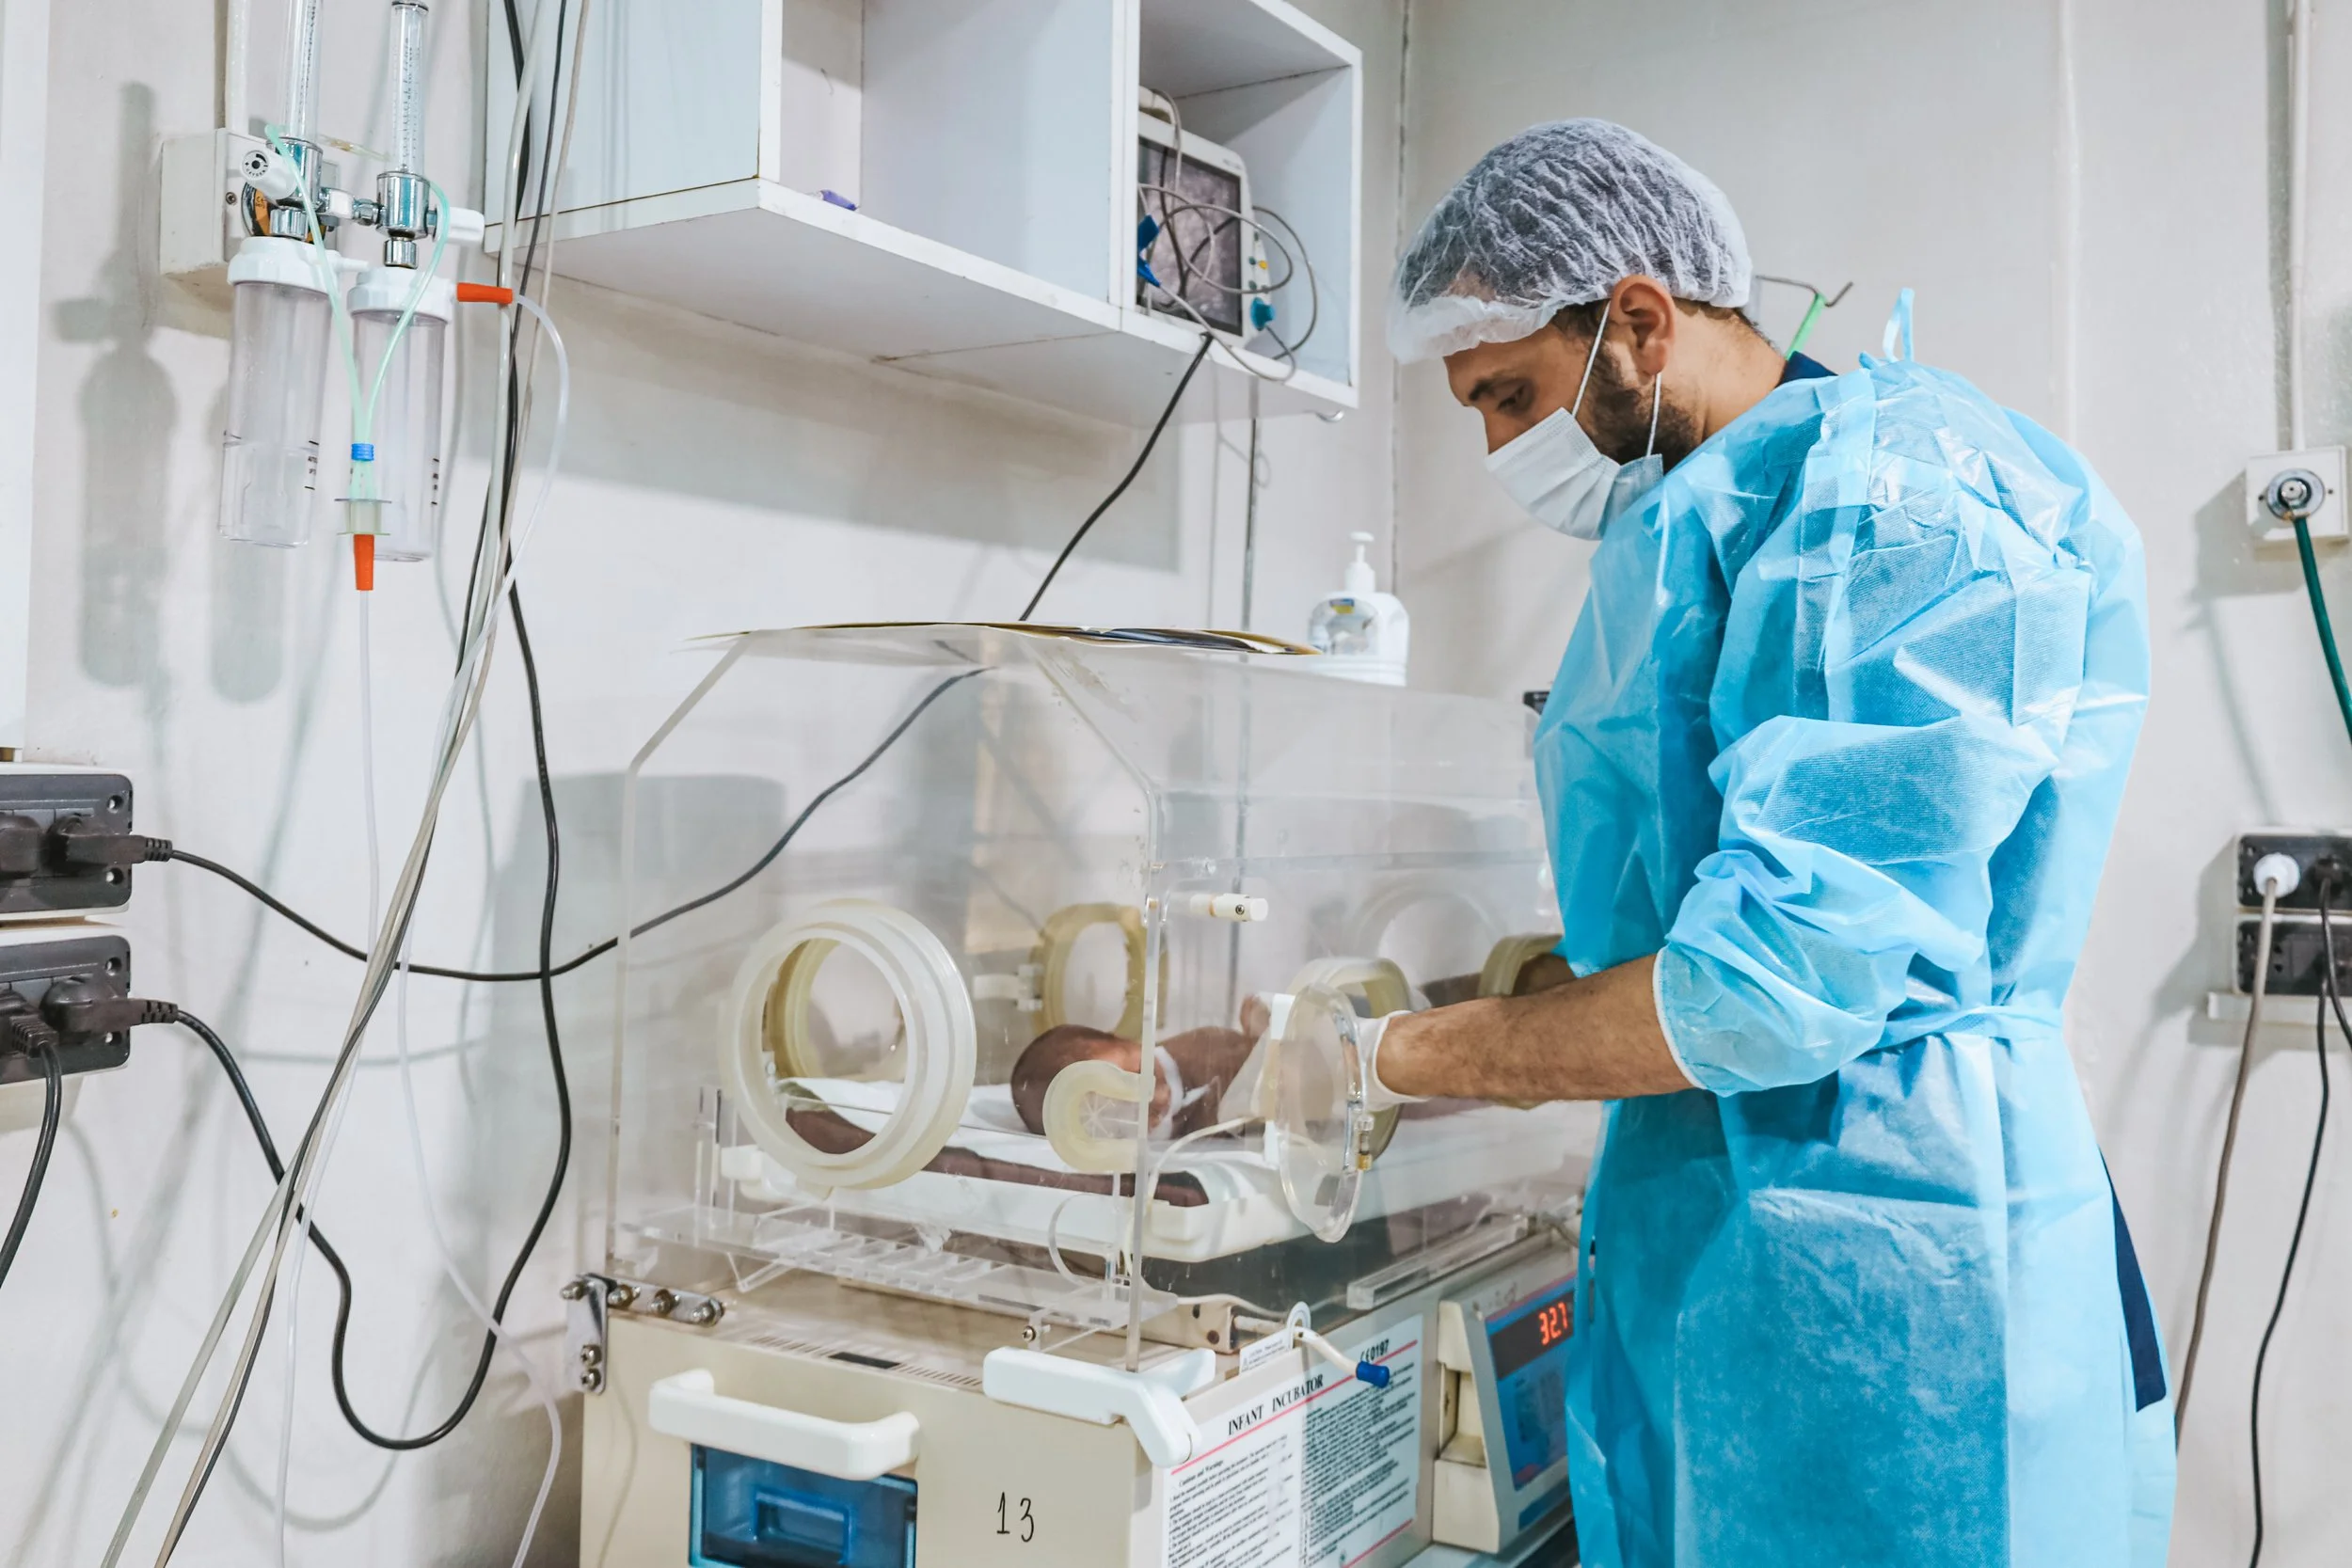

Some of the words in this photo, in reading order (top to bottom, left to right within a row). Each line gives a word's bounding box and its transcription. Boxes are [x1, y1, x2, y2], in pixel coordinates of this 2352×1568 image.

[1228, 1403, 1263, 1436] INFANT
[1272, 1373, 1324, 1413] INCUBATOR
[996, 1491, 1034, 1543] 13
